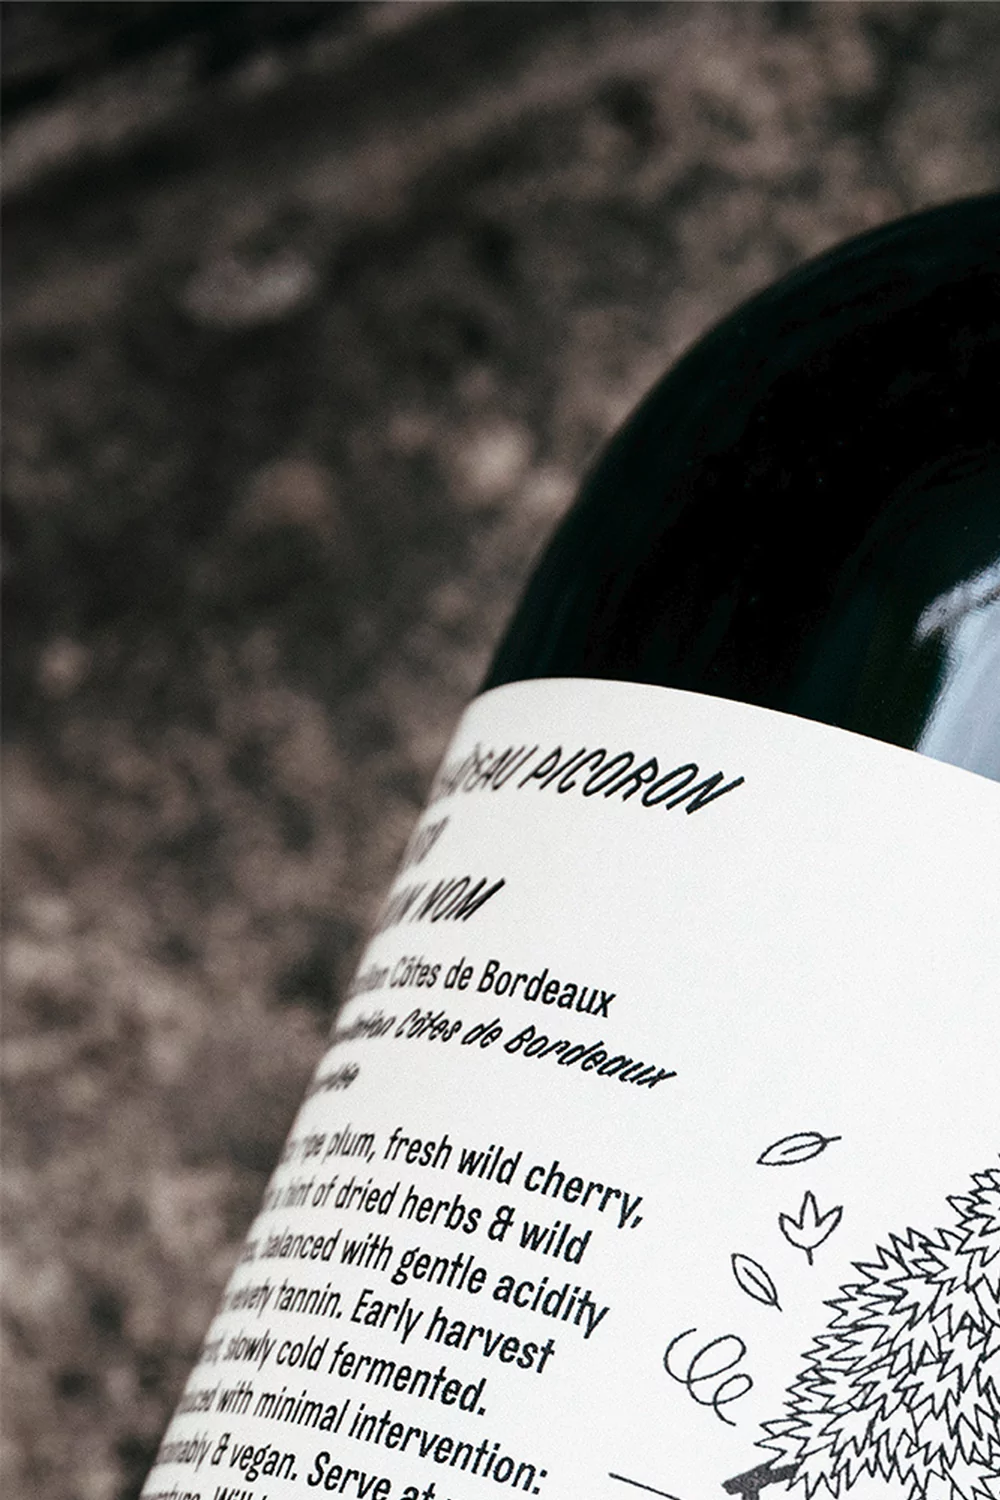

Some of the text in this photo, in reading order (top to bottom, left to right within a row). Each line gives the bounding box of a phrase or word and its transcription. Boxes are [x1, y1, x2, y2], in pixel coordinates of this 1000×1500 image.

[517, 744, 746, 815] PICORON
[444, 956, 474, 990] de
[477, 959, 617, 1018] Bordeaux
[461, 1018, 504, 1048] de
[504, 1025, 678, 1088] Bordeaux
[312, 1175, 339, 1208] of
[335, 1176, 400, 1215] dried
[398, 1185, 482, 1234] herbs
[488, 1205, 515, 1242] &
[519, 1220, 593, 1264] wild
[384, 1127, 452, 1169] fresh
[457, 1145, 523, 1185] wild
[524, 1160, 643, 1229] cherry,
[273, 1278, 342, 1319] tannin.
[350, 1289, 424, 1344] Early
[424, 1306, 555, 1373] harvest
[340, 1233, 393, 1271] with
[391, 1247, 487, 1294] gentle
[492, 1275, 610, 1339] acidity
[276, 1335, 329, 1371] cold
[328, 1341, 487, 1416] fermented.
[210, 1432, 232, 1466] &
[230, 1444, 297, 1482] vegan.
[215, 1381, 254, 1415] with
[253, 1386, 351, 1434] minimal
[347, 1403, 548, 1495] intervention:
